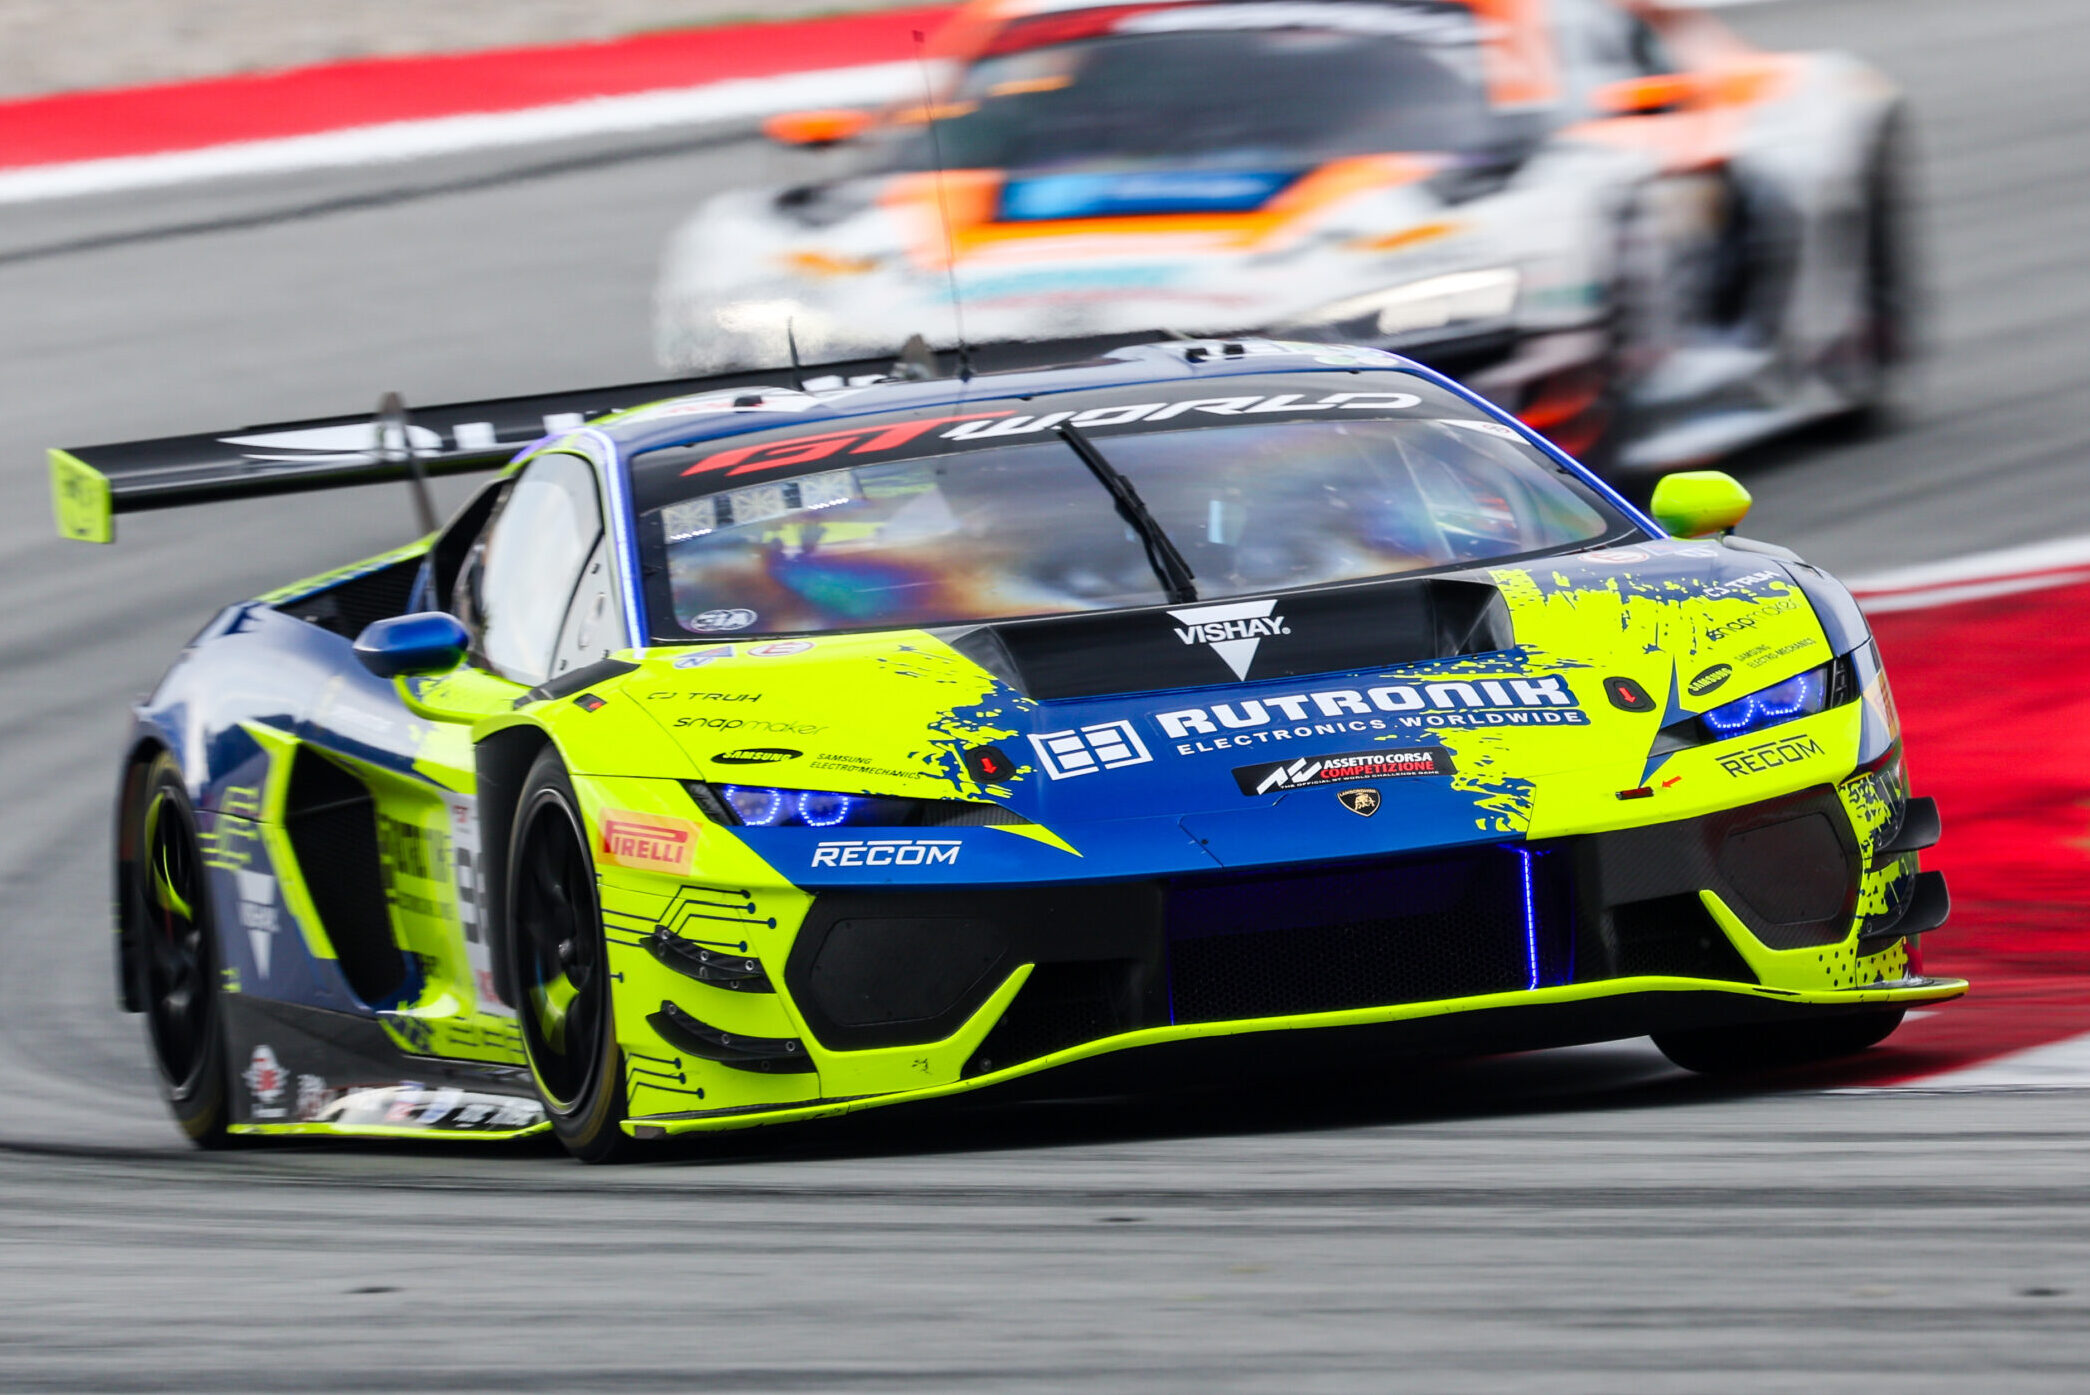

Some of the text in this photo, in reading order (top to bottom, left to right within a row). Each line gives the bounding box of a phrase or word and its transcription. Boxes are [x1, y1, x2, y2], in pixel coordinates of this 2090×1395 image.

[681, 411, 1018, 476] GT
[939, 391, 1421, 440] WORLD
[1688, 666, 1733, 693] SAMSUNG
[1156, 677, 1571, 738] RUTRONIK
[673, 717, 829, 735] snapmaker
[1177, 711, 1583, 756] ELECTRONICS WORLDWIDE
[720, 750, 794, 763] SAMSUNG
[816, 753, 873, 765] SAMSUNG
[1323, 752, 1433, 770] ASSETTO CORSA
[1715, 734, 1825, 778] RECOM
[1297, 779, 1332, 788] OFFICIAL
[1343, 774, 1371, 782] WORLD
[1372, 771, 1417, 779] CHALLENGE
[1320, 761, 1435, 779] COMPETIZIONE
[604, 820, 689, 864] PIRELLI
[812, 840, 962, 868] RECOM
